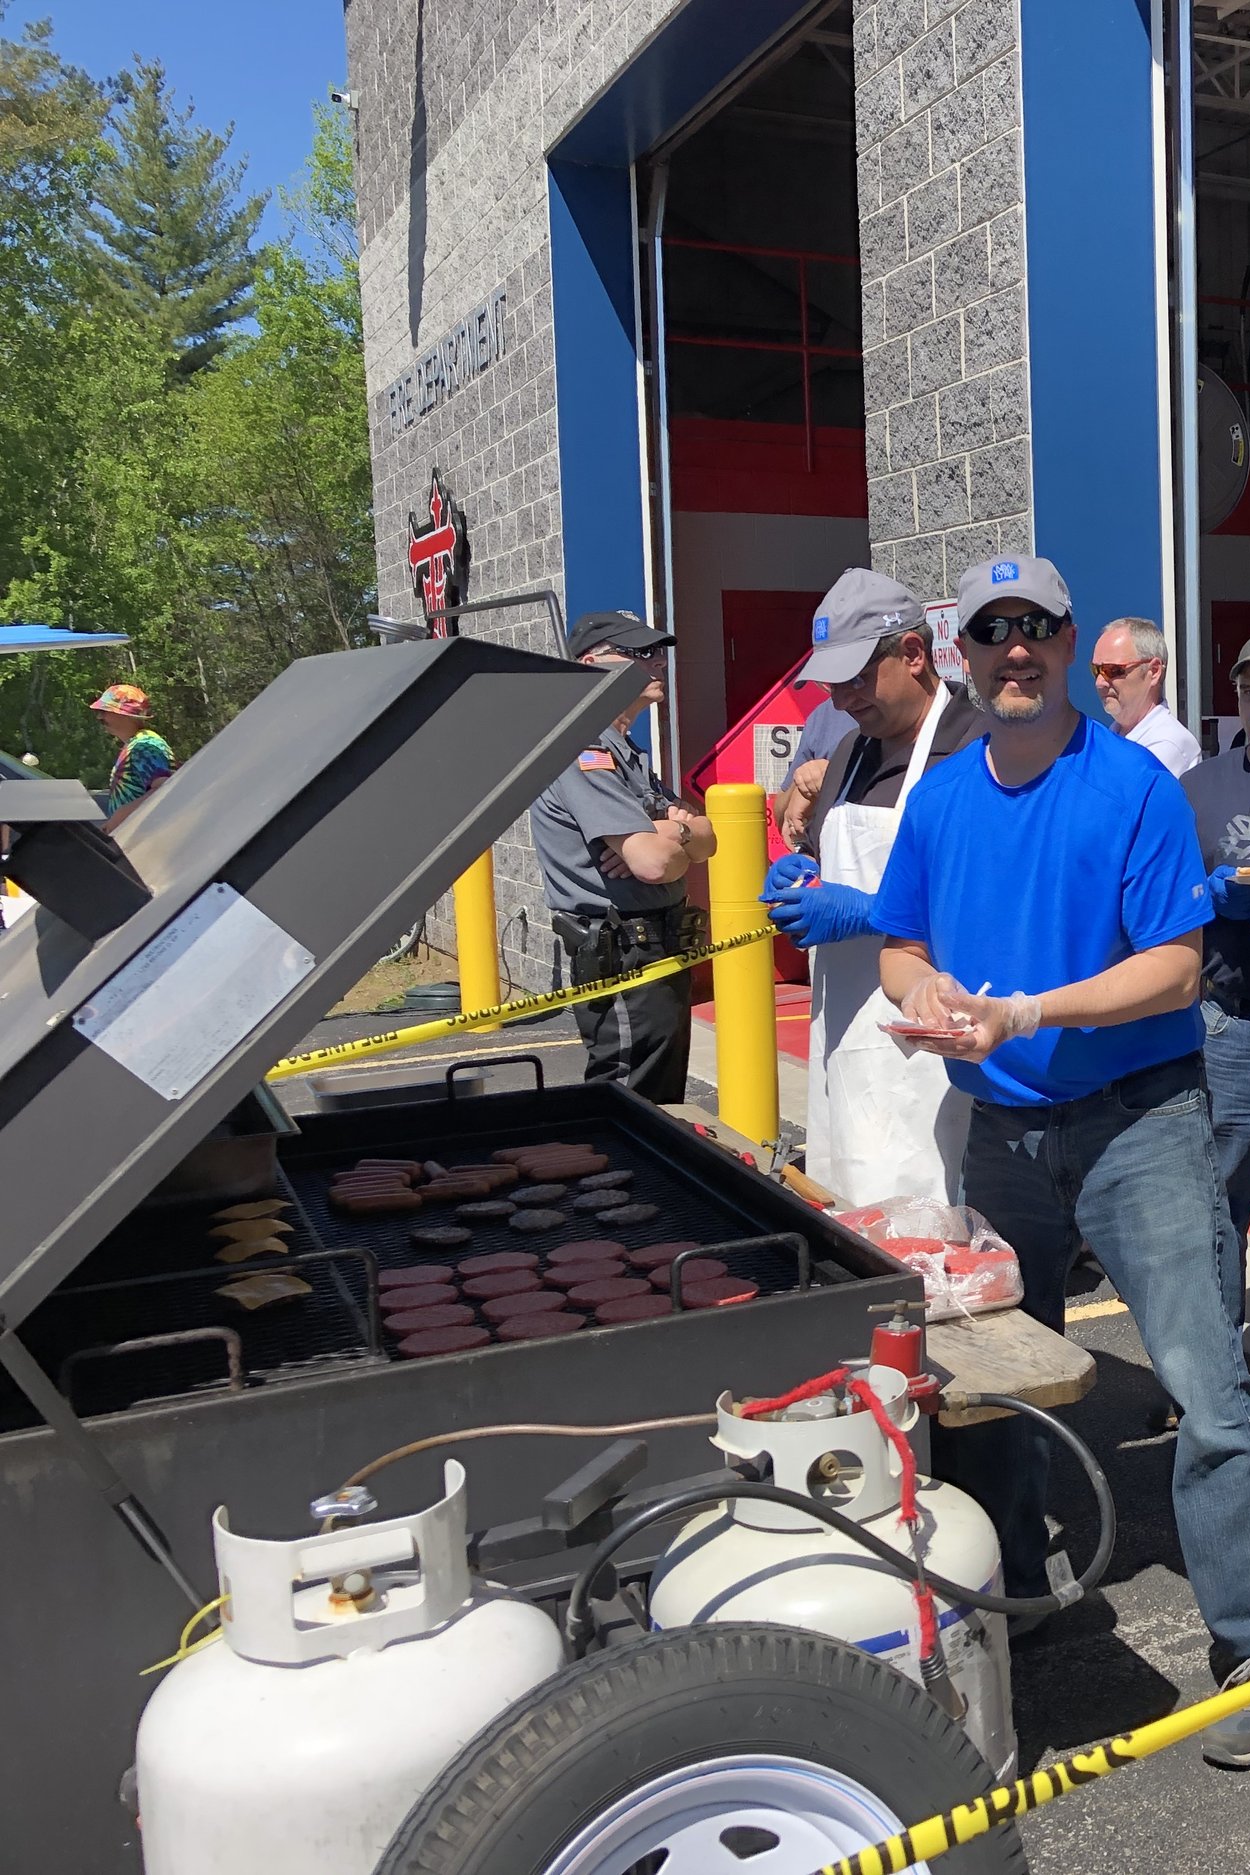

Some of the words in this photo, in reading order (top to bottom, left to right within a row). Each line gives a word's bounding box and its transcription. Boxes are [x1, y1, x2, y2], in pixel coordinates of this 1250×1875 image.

[415, 284, 507, 416] DEPARTMENT
[937, 620, 949, 640] NO
[933, 646, 961, 668] ARKING
